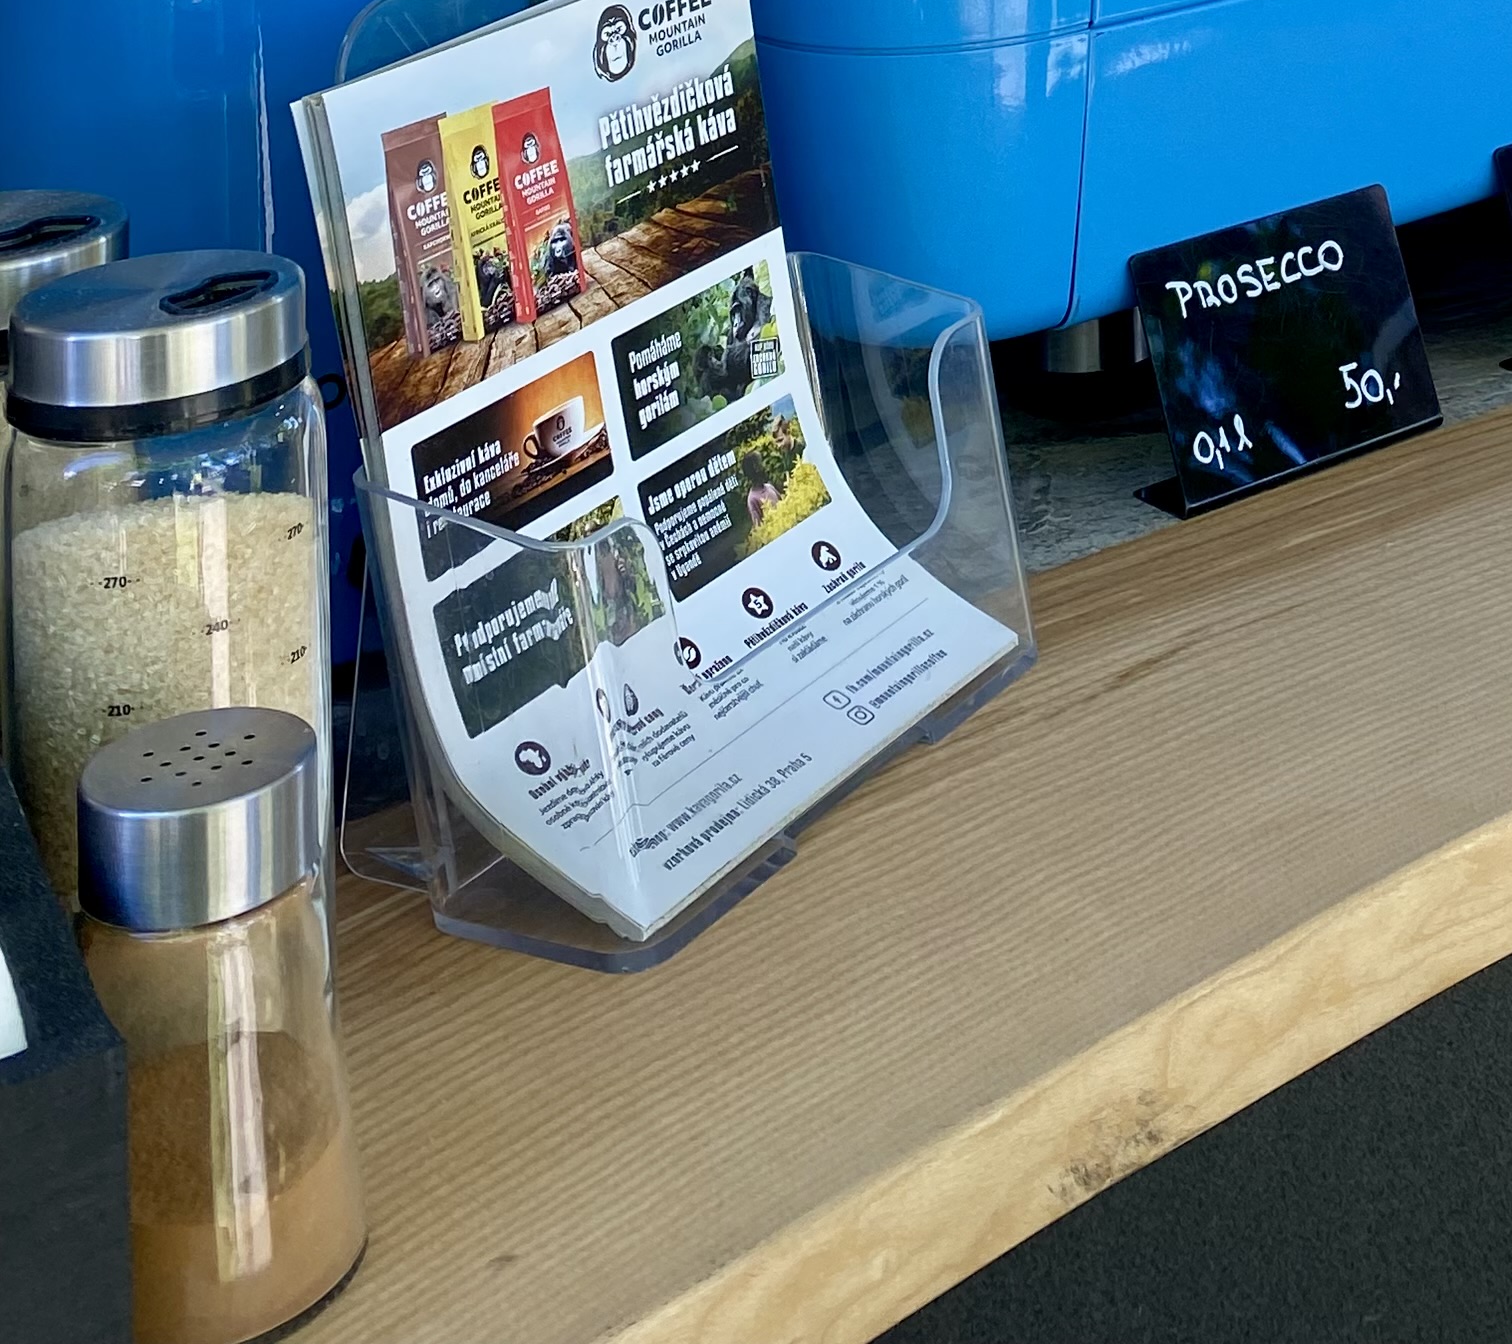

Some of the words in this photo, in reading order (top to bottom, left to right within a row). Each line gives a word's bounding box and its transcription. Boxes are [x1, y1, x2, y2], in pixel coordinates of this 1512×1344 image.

[649, 13, 706, 45] MOUNTAIN
[656, 32, 702, 57] GORILLA
[599, 64, 735, 150] Pětihvězdičková
[605, 119, 696, 188] farmářská
[697, 106, 737, 146] káva
[463, 177, 500, 205] COFFE
[514, 159, 560, 190] COFFEE
[407, 192, 448, 221] COFFE
[1165, 240, 1344, 319] PROSECCO
[628, 331, 682, 373] Pomáháme
[633, 361, 681, 400] horským
[638, 389, 680, 431] gorilám
[423, 449, 476, 494] Exkluzivní
[477, 439, 502, 462] káva
[459, 477, 472, 498] do
[474, 450, 520, 486] kanceláře
[648, 487, 675, 516] Jsme
[674, 466, 708, 500] oporou
[707, 450, 737, 479] dětem
[103, 576, 127, 589] 270
[753, 599, 763, 609] 5
[107, 704, 131, 717] 210
